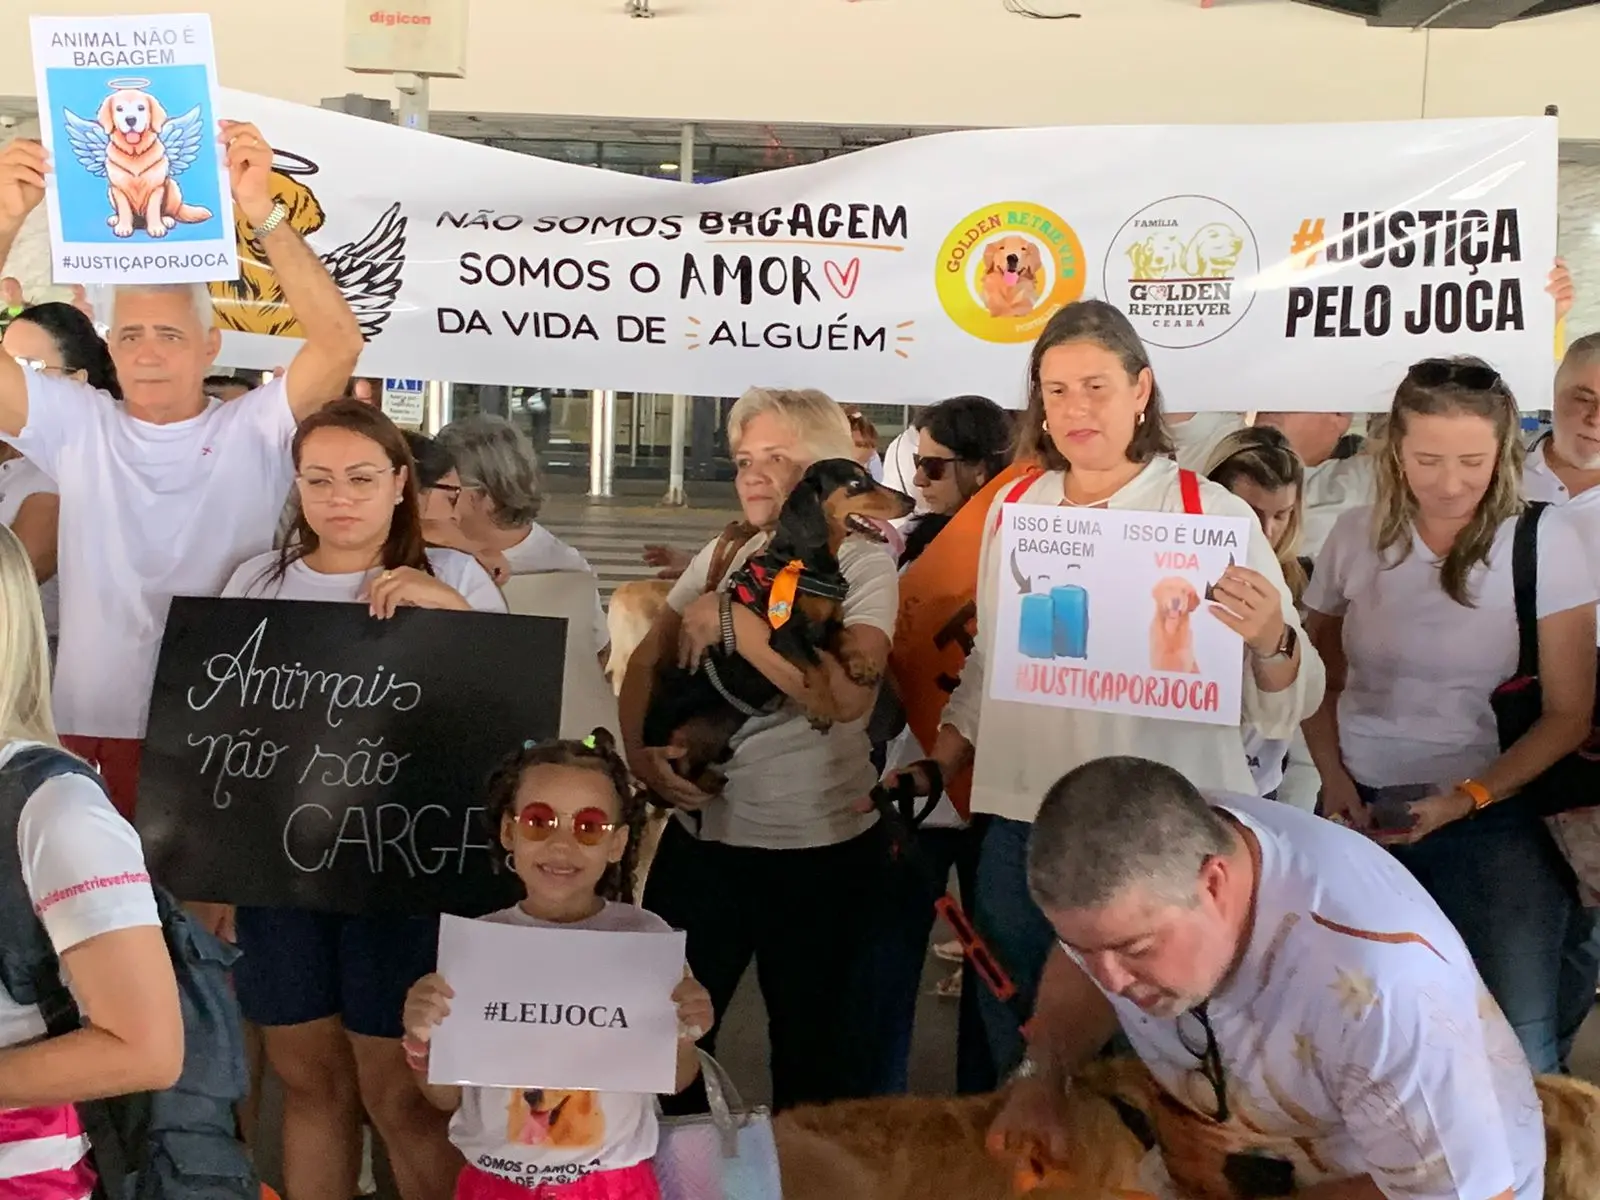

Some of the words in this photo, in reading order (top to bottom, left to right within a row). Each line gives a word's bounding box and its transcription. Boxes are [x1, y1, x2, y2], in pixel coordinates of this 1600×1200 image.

[369, 11, 431, 26] digicon
[51, 32, 127, 48] ANIMAL
[133, 27, 178, 46] NÃO
[183, 25, 195, 44] É
[73, 49, 175, 67] BAGAGEM
[436, 209, 521, 232] NÃO
[532, 213, 683, 240] SOMOS
[699, 203, 908, 240] BAGAGEM
[1133, 218, 1179, 228] FAMÍLIA
[946, 214, 1002, 273] GOLDEN
[1007, 211, 1076, 279] RETRIEVER
[62, 253, 229, 272] #JUSTIÇAPORJOCA
[458, 252, 611, 293] SOMOS
[629, 261, 661, 293] O
[679, 252, 822, 305] AMOR
[1128, 303, 1231, 316] RETRIEVER
[1285, 284, 1392, 338] PELO
[1404, 278, 1525, 335] JOCA
[438, 307, 494, 336] DA
[502, 310, 600, 341] VIDA
[617, 315, 667, 344] DE
[708, 313, 886, 352] ALGUÉM
[1013, 516, 1049, 533] ISSO
[1052, 515, 1062, 533] É
[1066, 519, 1102, 536] UMA
[1123, 523, 1169, 543] ISSO
[1174, 524, 1187, 544] É
[1192, 529, 1238, 548] UMA
[1017, 538, 1095, 558] BAGAGEM
[1154, 552, 1200, 571] VIDA
[187, 617, 421, 728] Animais
[1016, 663, 1219, 712] #JUSTIÇAPORJOCA
[187, 727, 290, 809] não
[298, 736, 411, 787] são
[483, 1001, 629, 1029] #LEIJOCA
[526, 1164, 538, 1174] O
